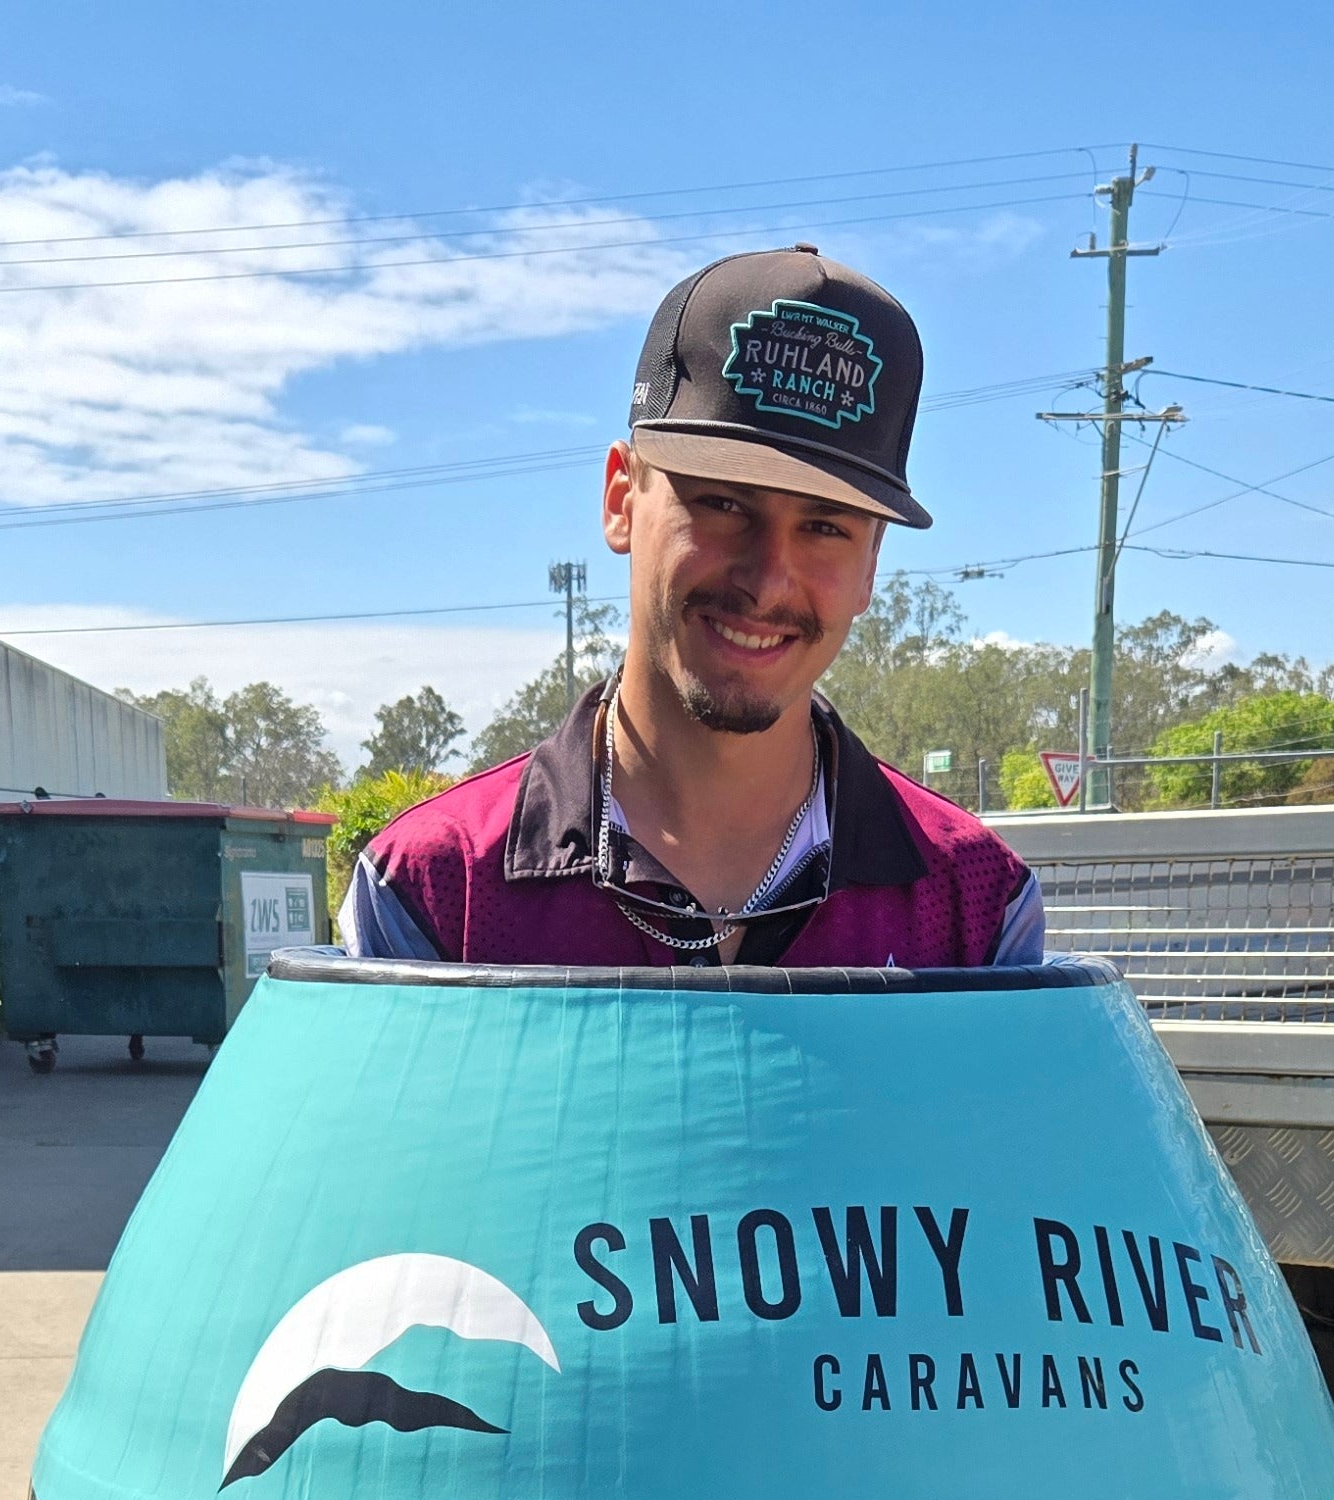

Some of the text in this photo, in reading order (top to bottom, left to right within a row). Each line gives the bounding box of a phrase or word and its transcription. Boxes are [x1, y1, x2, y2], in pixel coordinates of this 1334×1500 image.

[771, 321, 822, 349] Bucking
[816, 316, 850, 334] WALKER
[745, 339, 865, 388] RUHLAND
[772, 369, 835, 401] RANCH
[772, 393, 827, 416] CIRCA 1860
[1054, 763, 1079, 774] GIVE
[573, 1205, 1263, 1357] SNOWY RIVER
[813, 1353, 1144, 1413] CARAVANS
